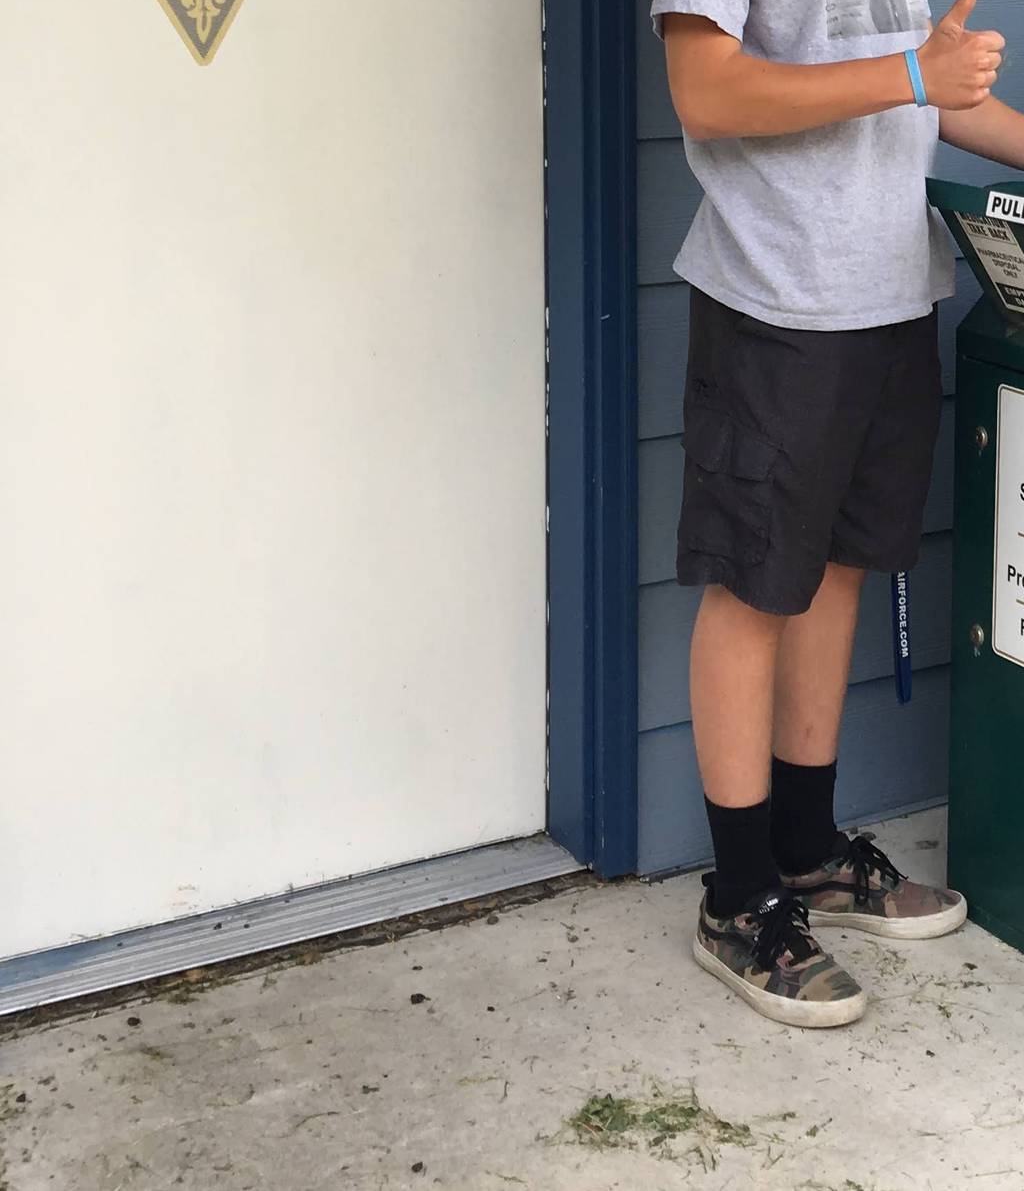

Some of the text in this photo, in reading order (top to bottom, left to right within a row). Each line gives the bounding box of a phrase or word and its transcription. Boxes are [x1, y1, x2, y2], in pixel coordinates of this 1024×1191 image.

[966, 222, 1011, 242] TAKE BACK
[897, 571, 908, 658] AIRFORCE.COM
